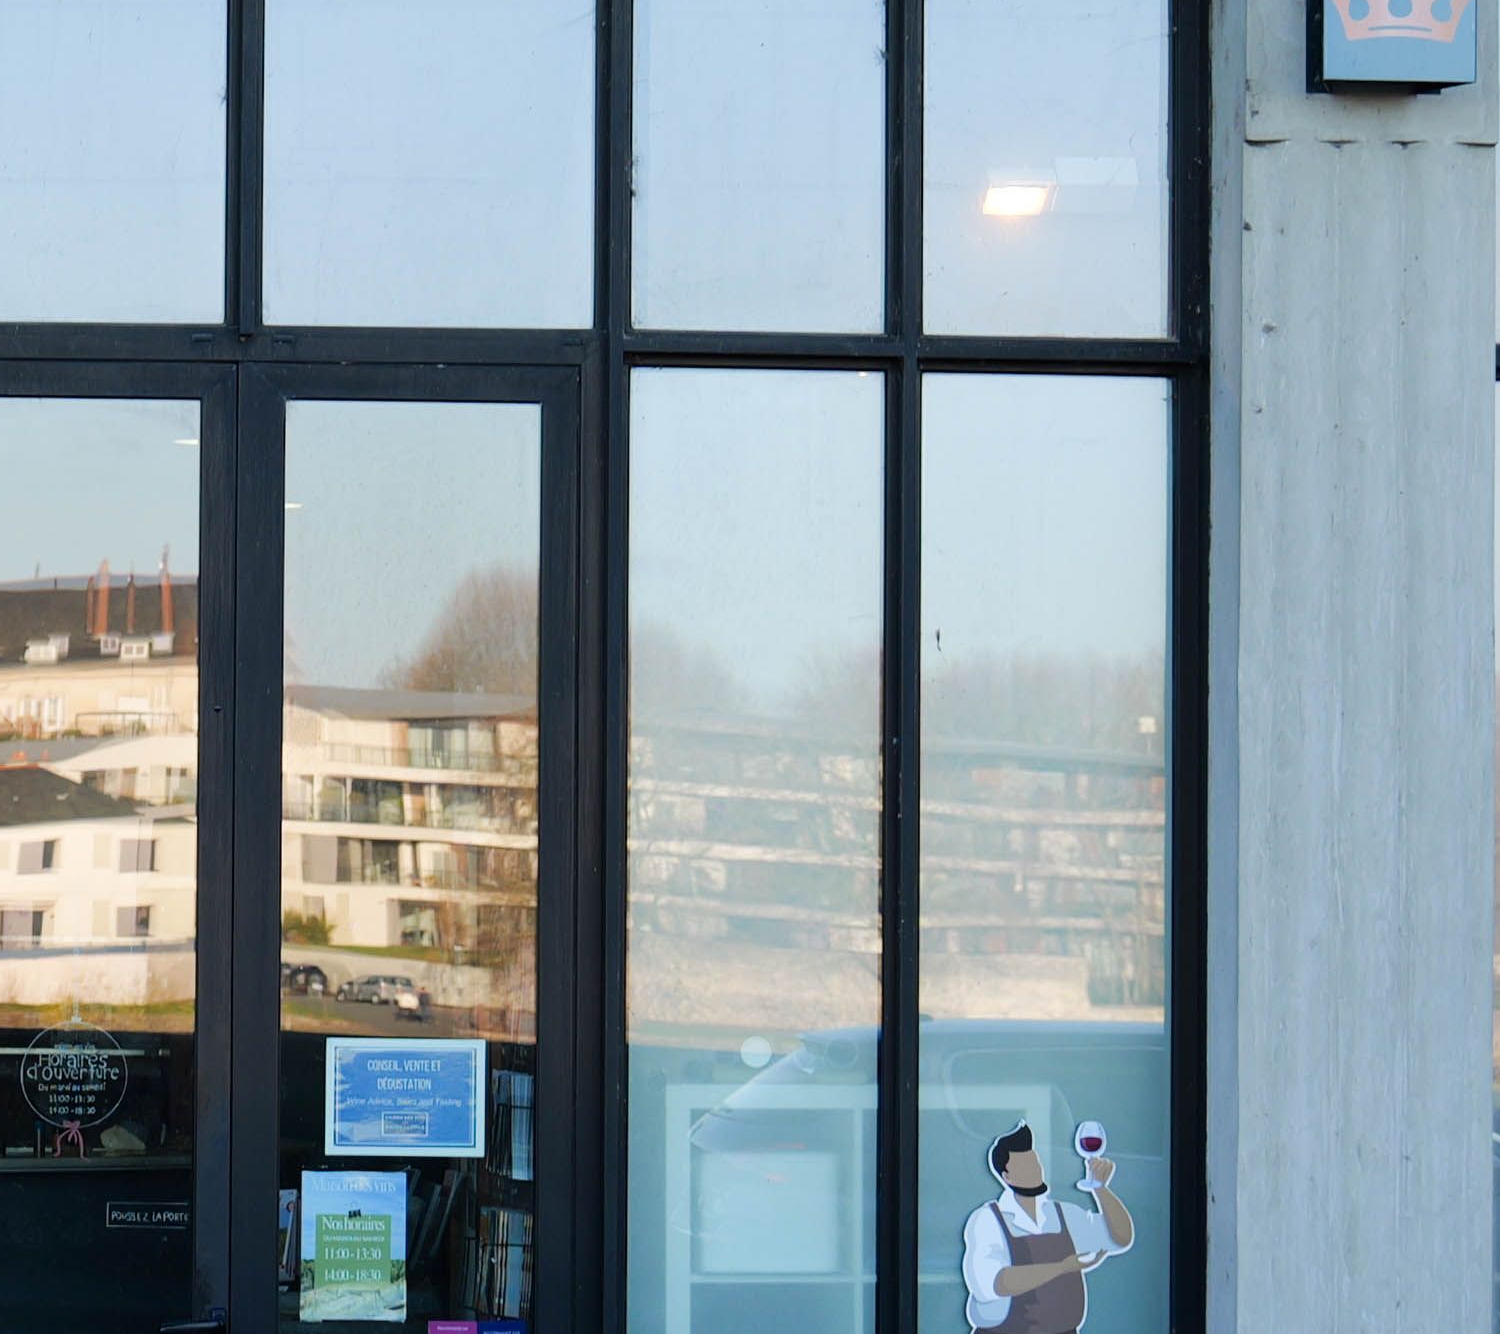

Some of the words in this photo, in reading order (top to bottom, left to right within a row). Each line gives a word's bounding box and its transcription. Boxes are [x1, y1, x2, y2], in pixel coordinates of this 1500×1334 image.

[39, 1053, 108, 1068] Horaires
[403, 1059, 430, 1071] VENTE
[377, 1076, 432, 1091] DÉGUSTATION
